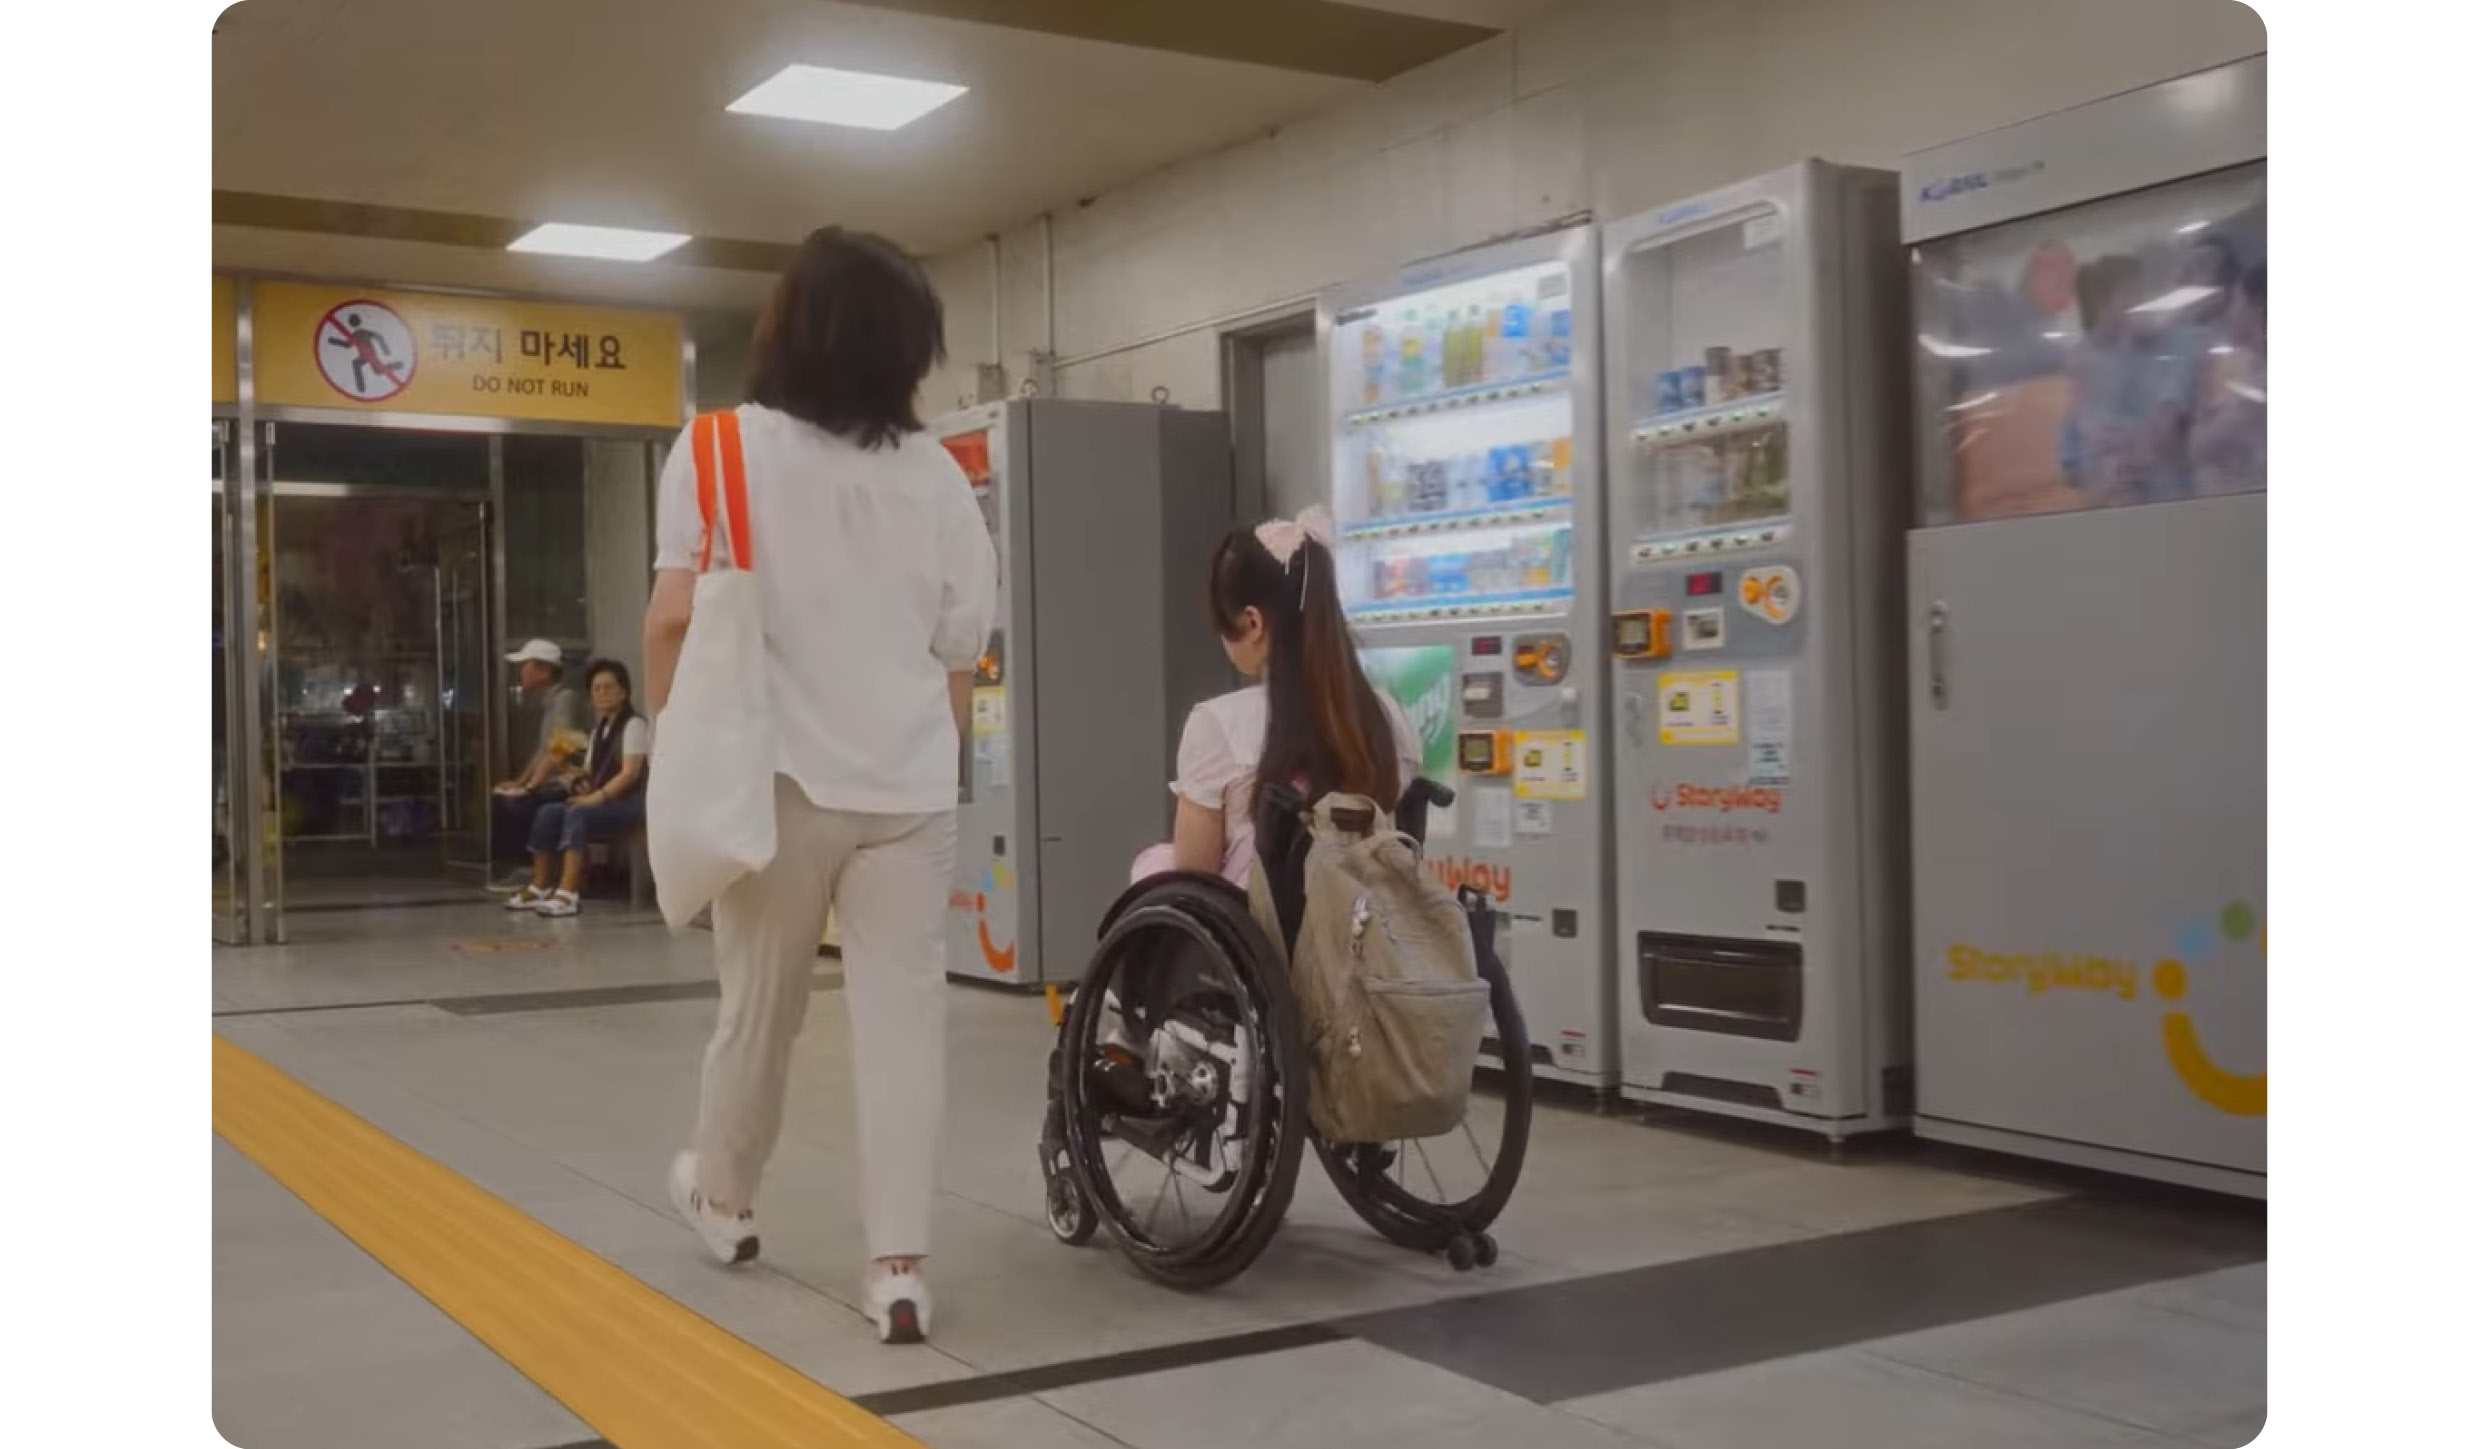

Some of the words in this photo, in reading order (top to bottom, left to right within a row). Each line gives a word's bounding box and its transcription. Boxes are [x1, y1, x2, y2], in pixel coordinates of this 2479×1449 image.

[431, 324, 503, 364] 뛰지
[520, 329, 627, 370] 마세요
[472, 375, 501, 393] DO
[507, 377, 546, 395] NOT
[551, 380, 589, 397] RUN
